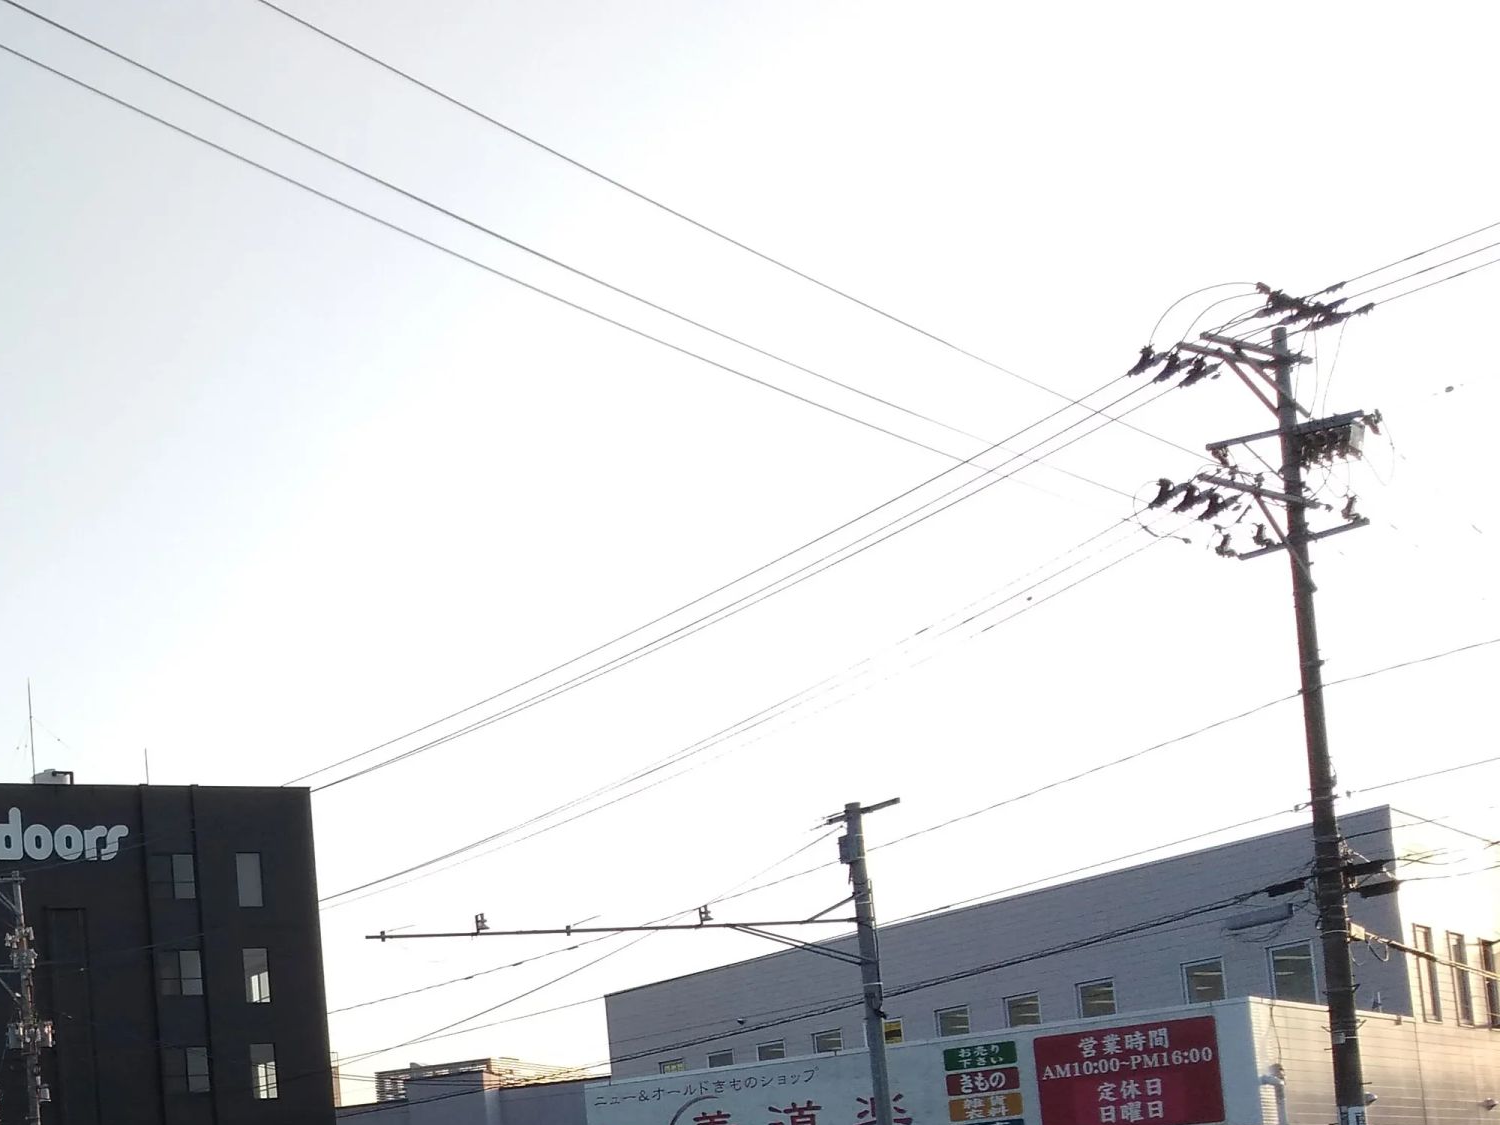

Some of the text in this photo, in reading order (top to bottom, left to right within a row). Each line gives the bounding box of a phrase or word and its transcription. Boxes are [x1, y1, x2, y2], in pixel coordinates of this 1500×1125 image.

[958, 1044, 1000, 1058] お売り
[1078, 1027, 1170, 1058] 営業時間
[958, 1056, 1004, 1068] 下さい
[960, 1071, 1006, 1093] きもの
[1097, 1078, 1163, 1102] 定休日
[1099, 1100, 1164, 1124] 日曜日
